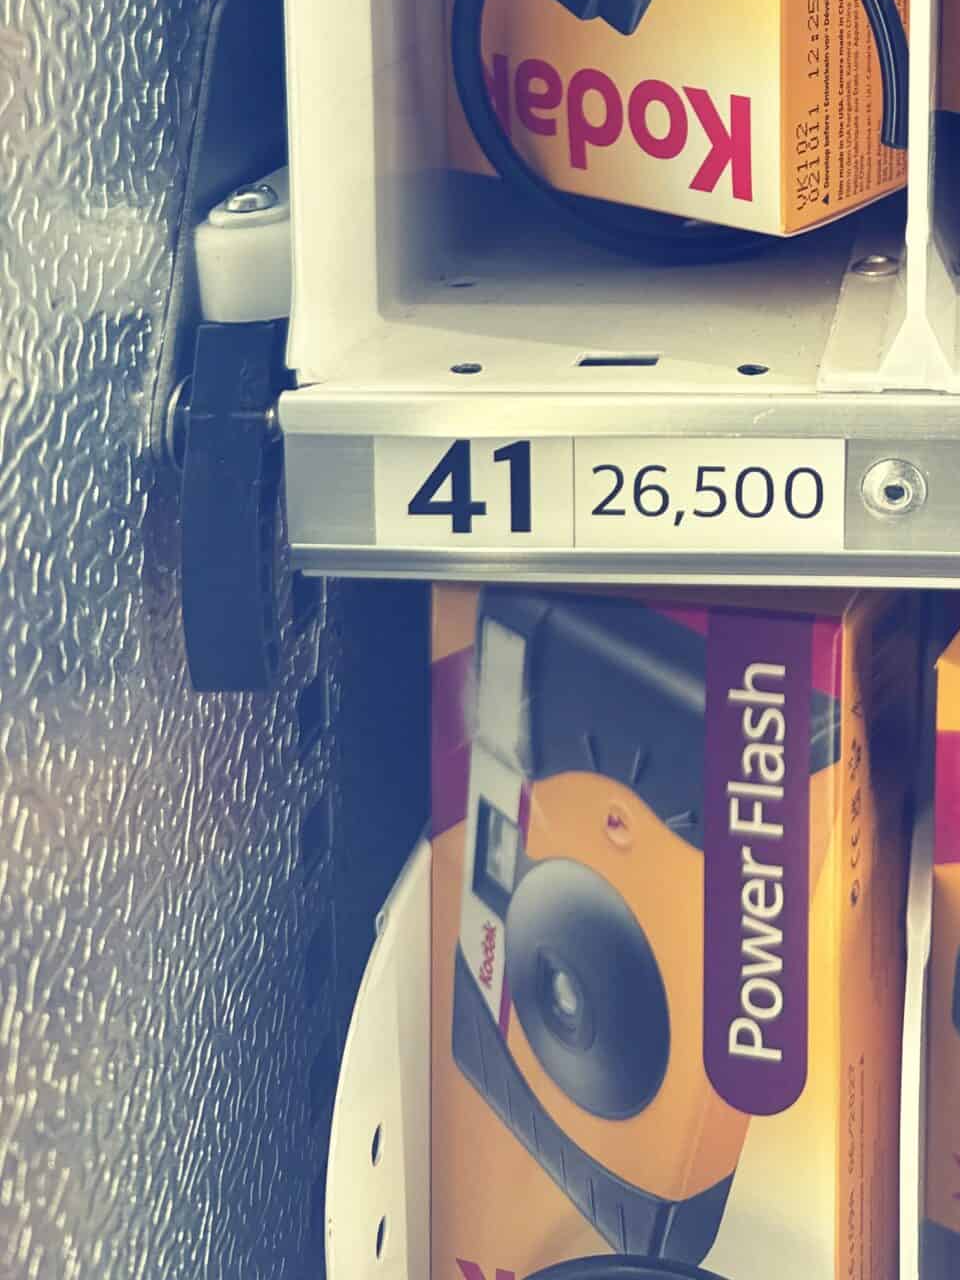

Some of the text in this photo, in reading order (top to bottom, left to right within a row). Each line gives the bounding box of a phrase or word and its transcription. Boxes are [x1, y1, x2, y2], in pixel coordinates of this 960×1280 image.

[408, 439, 531, 533] 41
[591, 464, 825, 527] 26,500
[726, 661, 786, 1063] Power Flash
